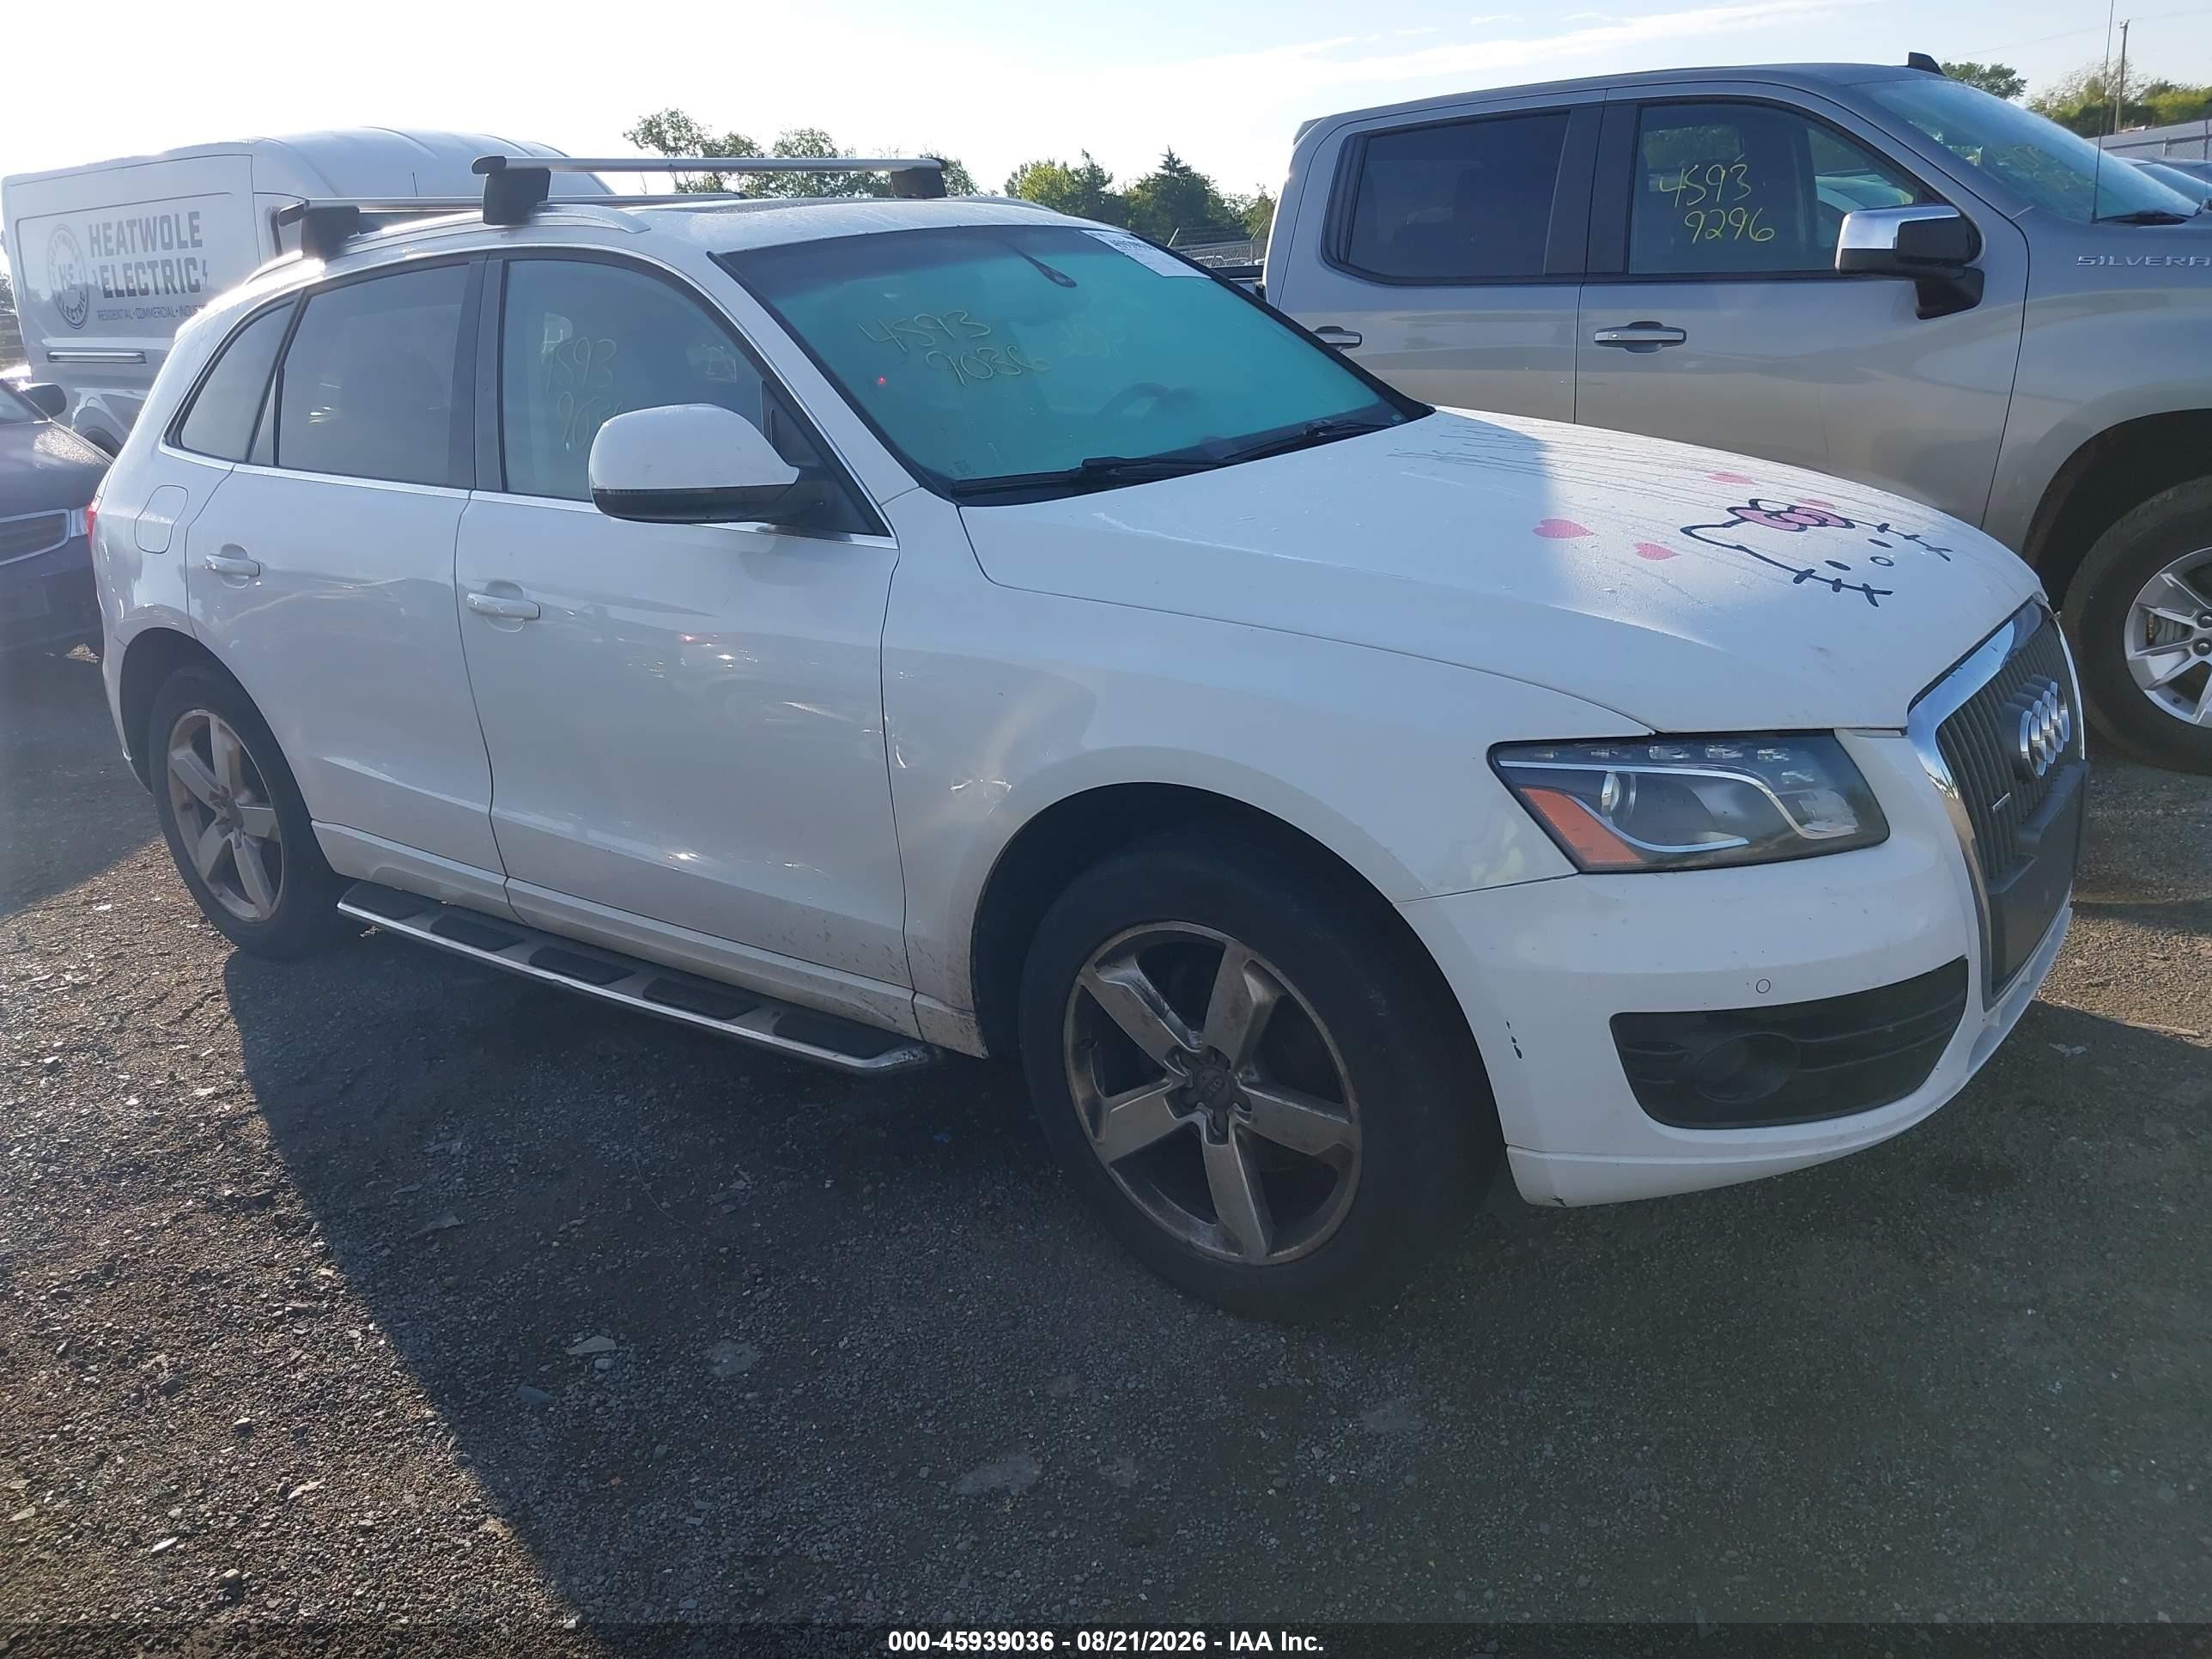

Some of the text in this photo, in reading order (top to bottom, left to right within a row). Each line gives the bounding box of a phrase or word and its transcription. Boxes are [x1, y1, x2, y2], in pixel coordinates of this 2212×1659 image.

[1659, 160, 1752, 207] 4593
[88, 211, 203, 258] HEATWOLE
[1684, 207, 1775, 244] 9296
[99, 258, 201, 298] ELECTRIC
[2076, 256, 2211, 266] SILVERA
[859, 310, 991, 353] 4593
[926, 344, 1051, 386] 9036
